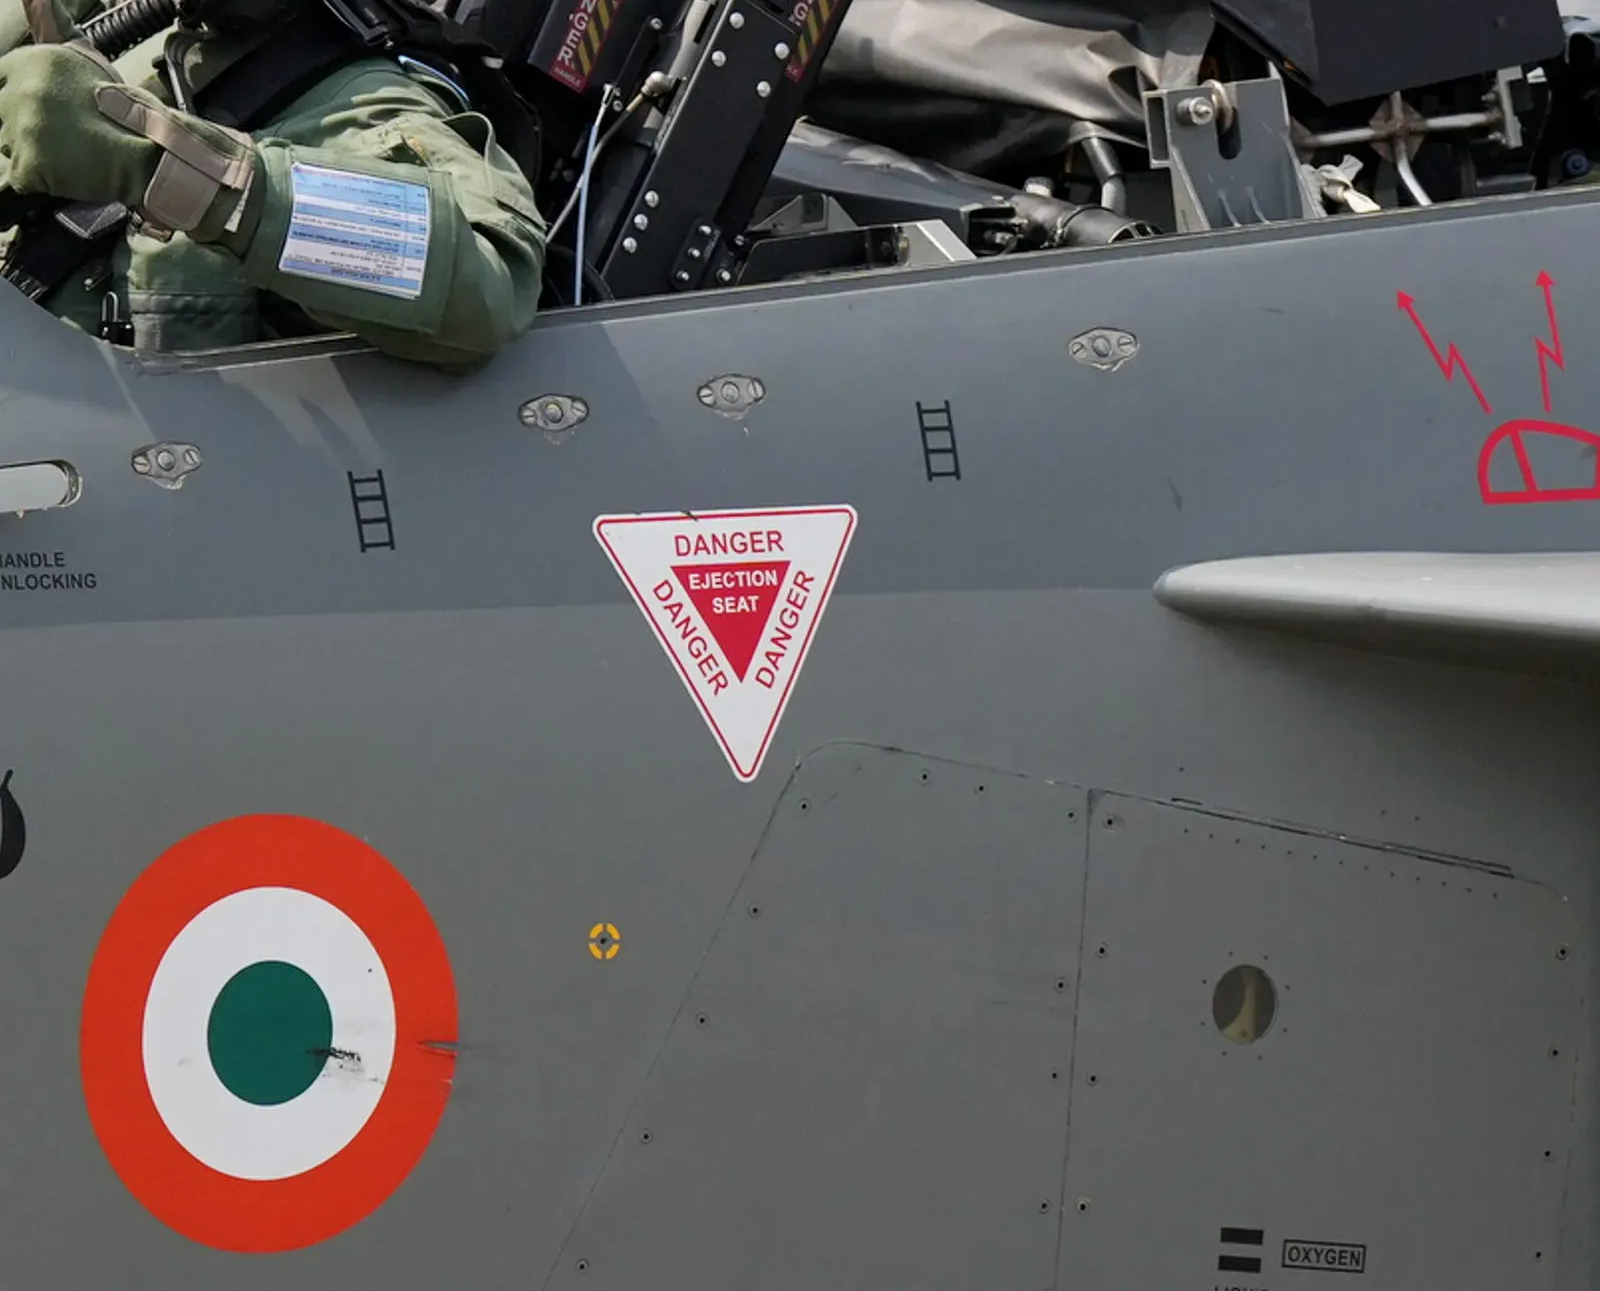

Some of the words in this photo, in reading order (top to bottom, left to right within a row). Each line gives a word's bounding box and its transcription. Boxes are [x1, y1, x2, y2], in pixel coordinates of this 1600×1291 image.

[673, 530, 785, 557] DANGER
[688, 569, 778, 590] EJECTION
[711, 595, 760, 614] SEAT
[652, 579, 729, 696] DANGER
[755, 570, 815, 689] DANGER
[1287, 1245, 1362, 1267] OXYGEN
